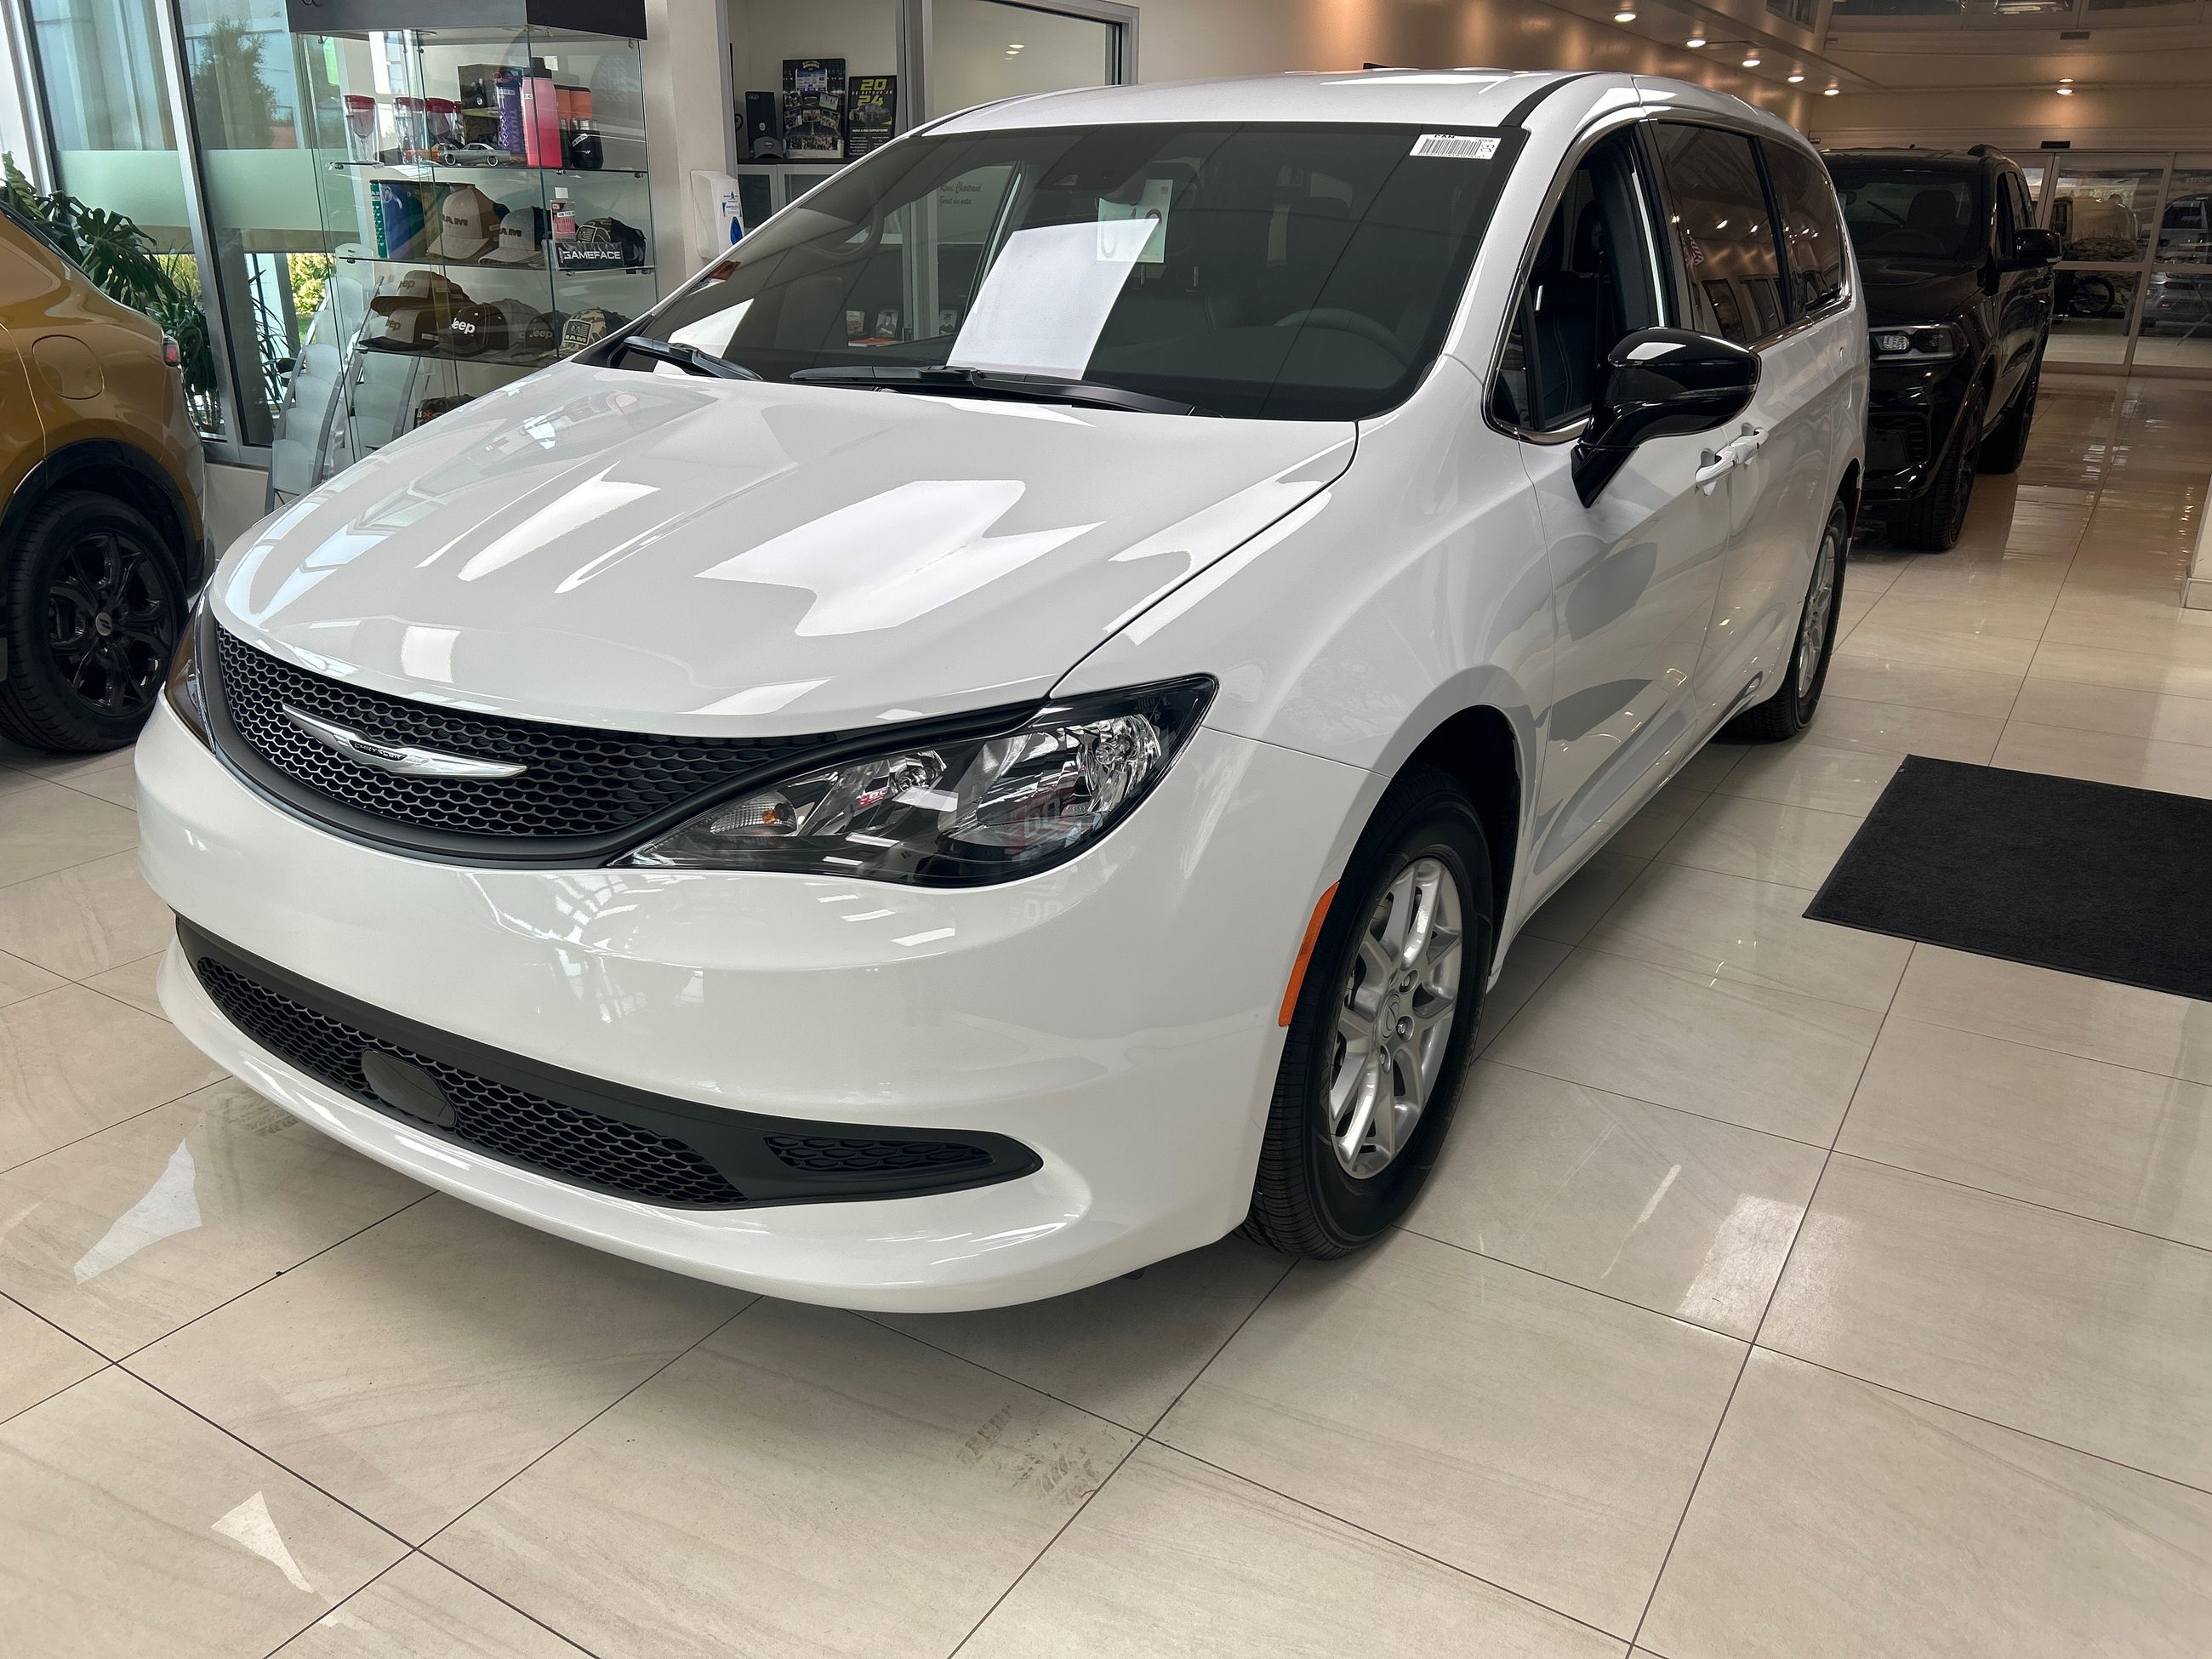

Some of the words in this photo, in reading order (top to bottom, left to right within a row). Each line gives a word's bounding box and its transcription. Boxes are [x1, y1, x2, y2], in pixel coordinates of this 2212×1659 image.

[860, 79, 887, 91] 20
[858, 94, 884, 107] 24
[499, 227, 522, 237] AM
[562, 251, 621, 259] GAMEFACE
[450, 317, 476, 334] Jeep
[529, 328, 552, 339] Jeep
[565, 334, 587, 343] RAM
[354, 742, 401, 760] CHRYSLER
